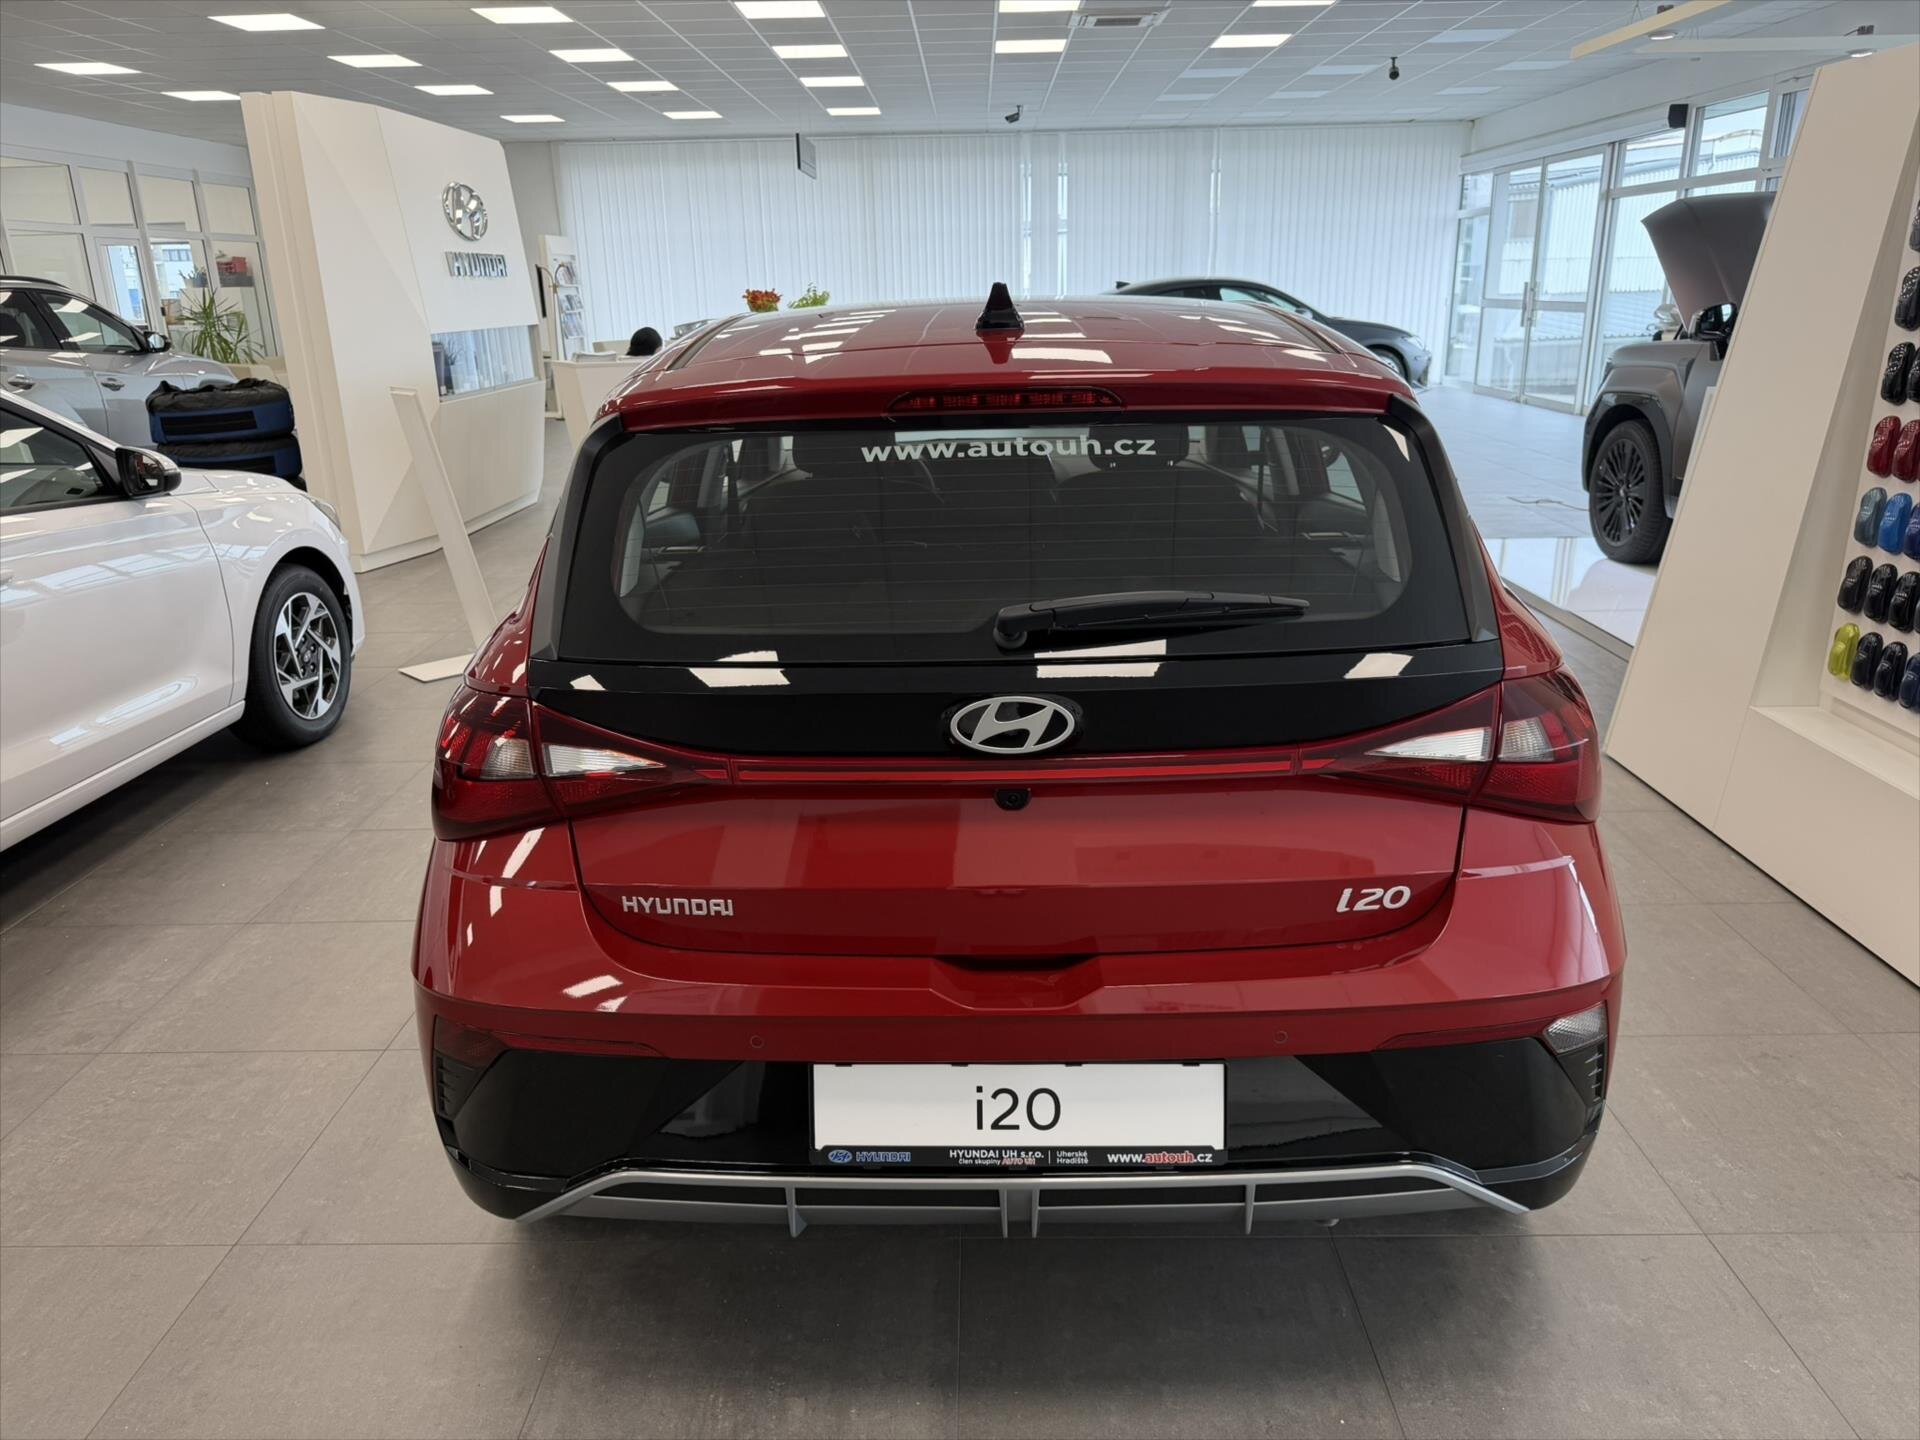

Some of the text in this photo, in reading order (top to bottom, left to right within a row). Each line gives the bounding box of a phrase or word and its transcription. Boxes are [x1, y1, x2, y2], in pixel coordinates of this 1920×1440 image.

[861, 436, 1157, 463] www.autouh.cz
[621, 896, 734, 916] HYUNDAI
[976, 1085, 1061, 1131] i20
[855, 1151, 911, 1162] HYUNDAI
[949, 1149, 1044, 1159] HYUNDAI UH s.r.o.
[1106, 1150, 1213, 1164] www.autouh.cz
